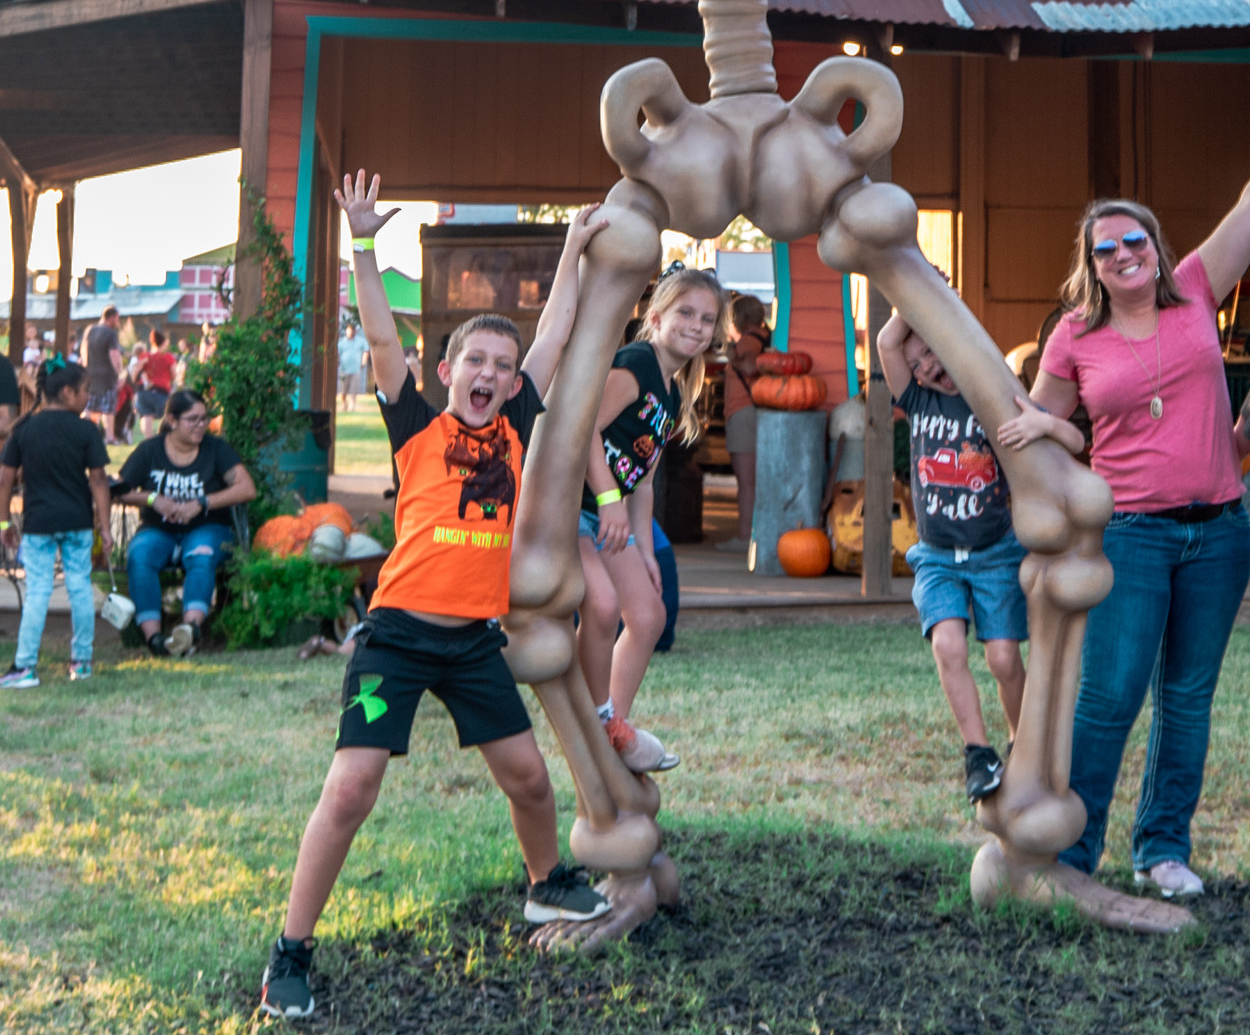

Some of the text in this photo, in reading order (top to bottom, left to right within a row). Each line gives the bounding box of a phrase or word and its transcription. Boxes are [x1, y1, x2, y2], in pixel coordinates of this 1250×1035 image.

[926, 492, 984, 522] Y'all
[433, 525, 469, 546] HANGIN'
[471, 530, 492, 549] WITH
